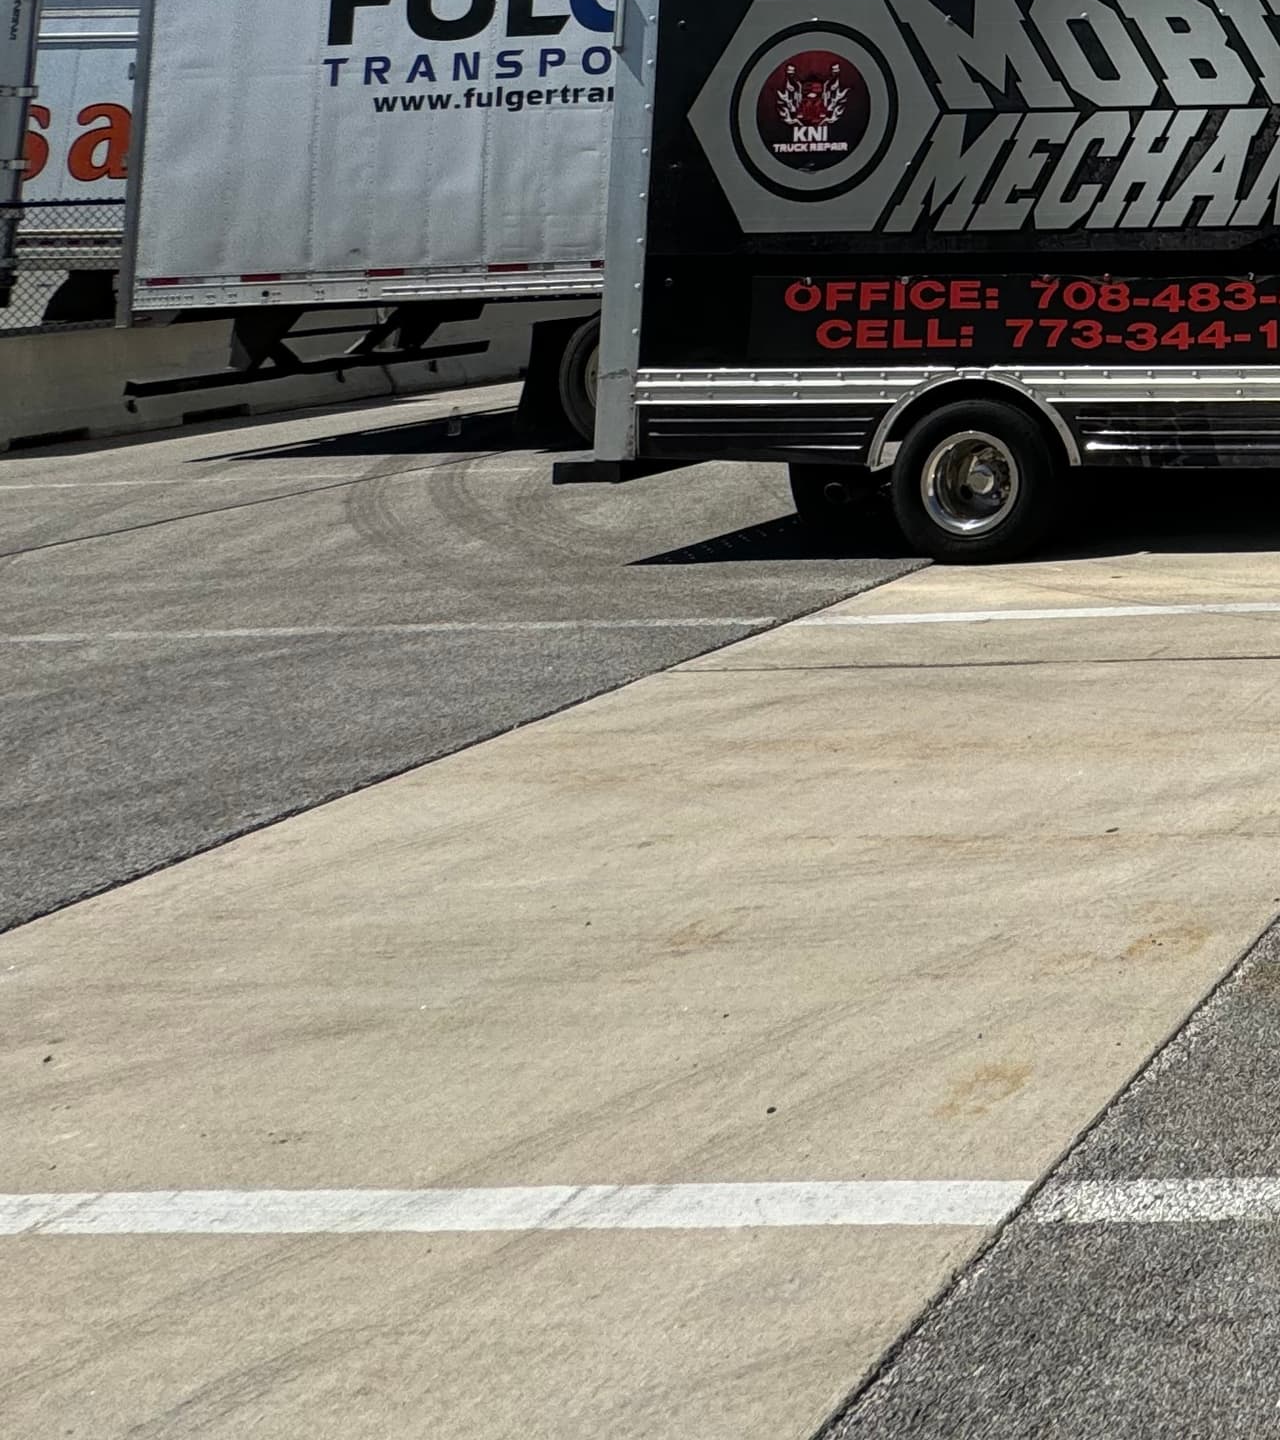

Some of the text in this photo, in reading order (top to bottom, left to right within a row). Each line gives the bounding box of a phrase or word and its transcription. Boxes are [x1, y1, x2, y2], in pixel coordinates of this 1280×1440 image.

[323, 46, 612, 87] TRANSPO
[373, 86, 614, 112] www.fulgertra
[773, 142, 848, 153] TRUCK REPAIR
[793, 126, 828, 142] KNI
[784, 280, 999, 312] OFFICE:
[816, 319, 973, 349] CELL:
